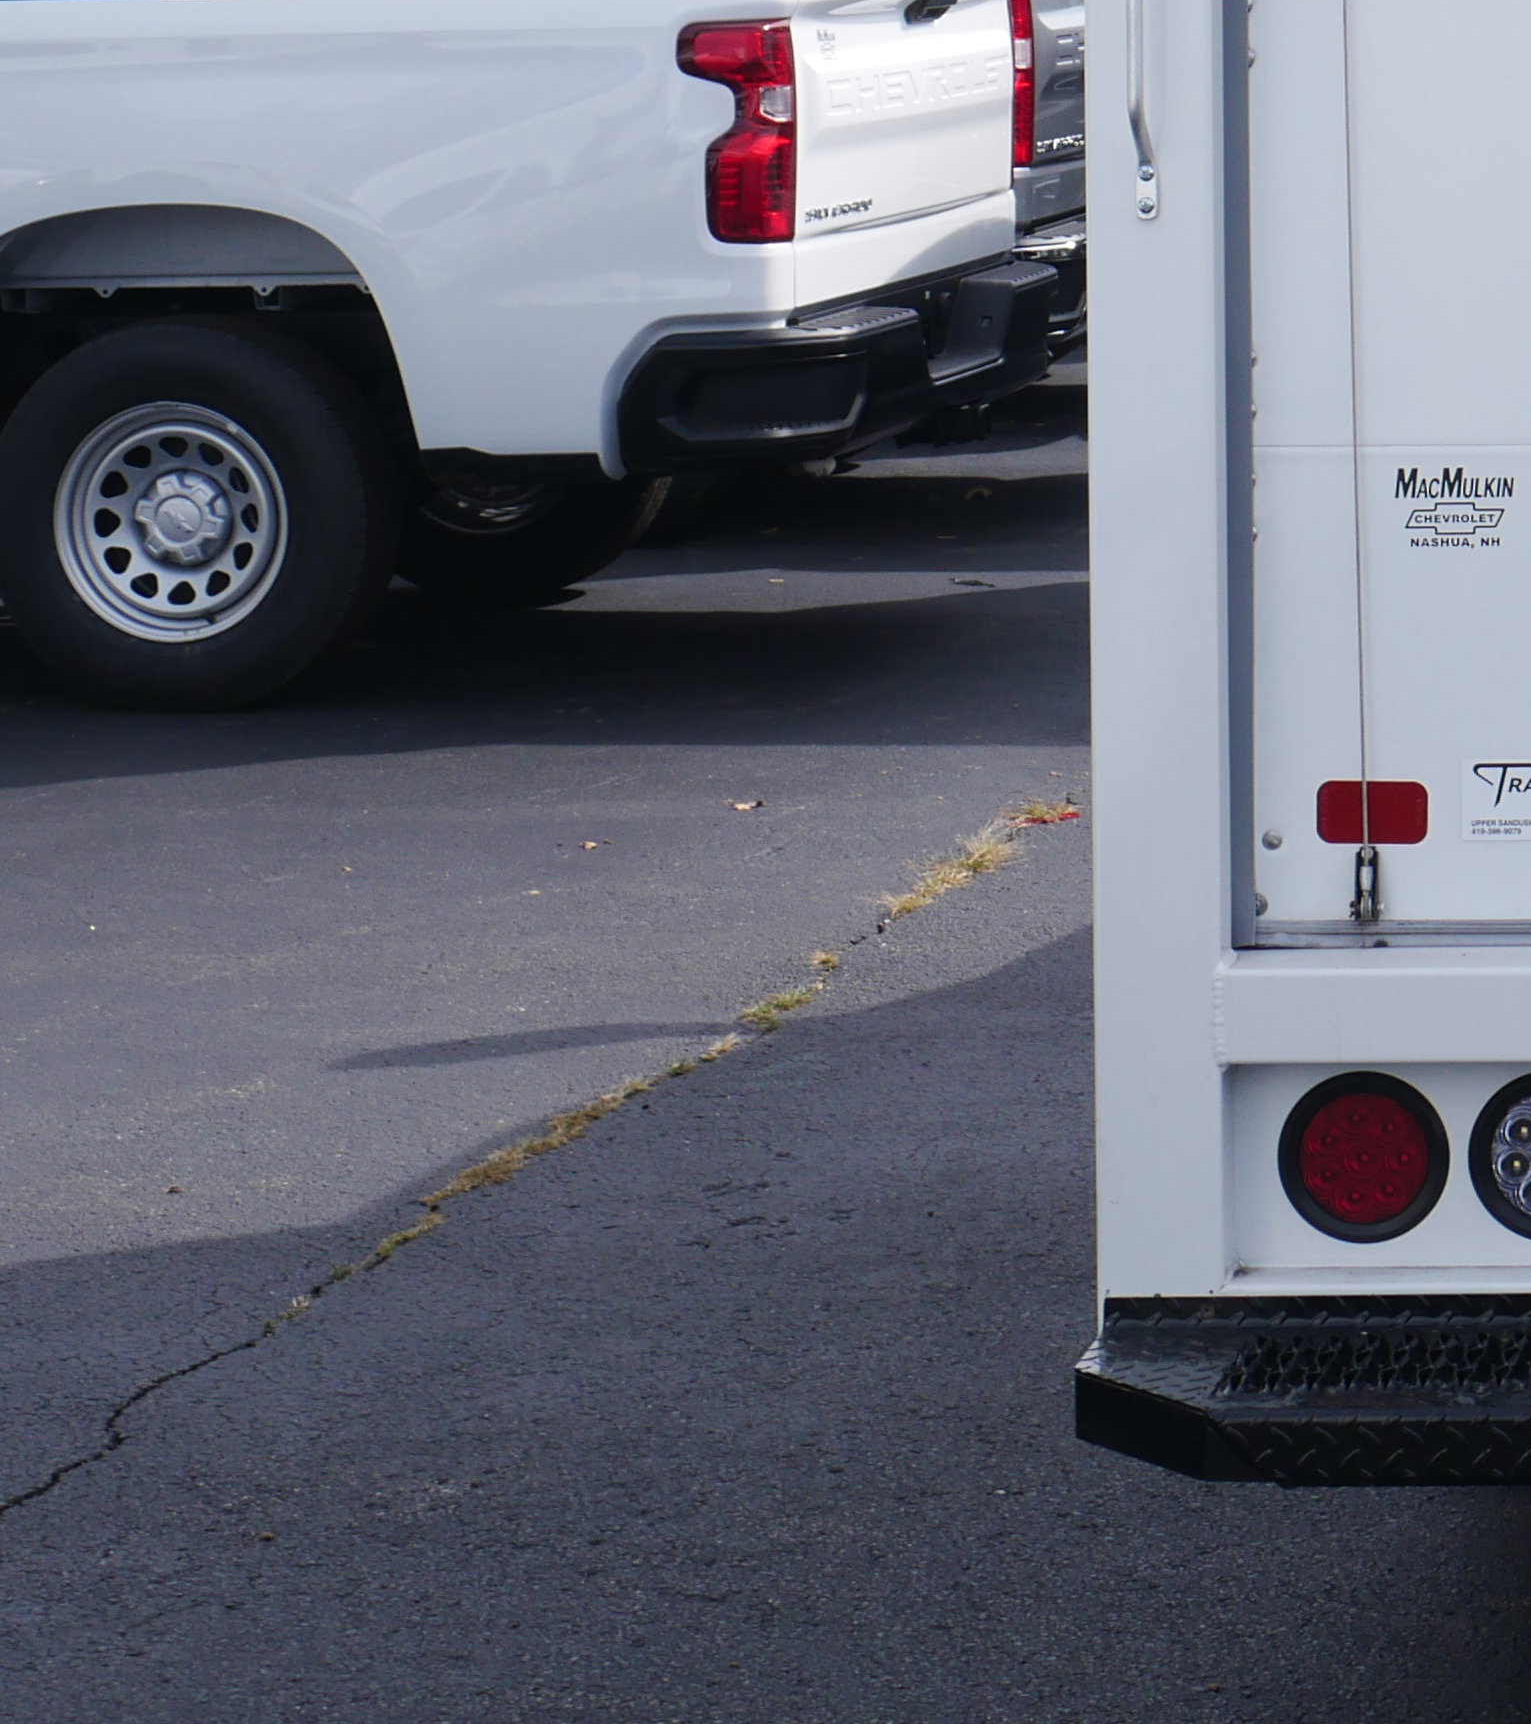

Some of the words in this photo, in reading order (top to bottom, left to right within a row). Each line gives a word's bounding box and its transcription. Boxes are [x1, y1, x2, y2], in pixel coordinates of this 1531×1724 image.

[1414, 513, 1496, 524] CHEVROLET
[1410, 537, 1475, 549] NASHUA,
[1480, 537, 1501, 547] NH
